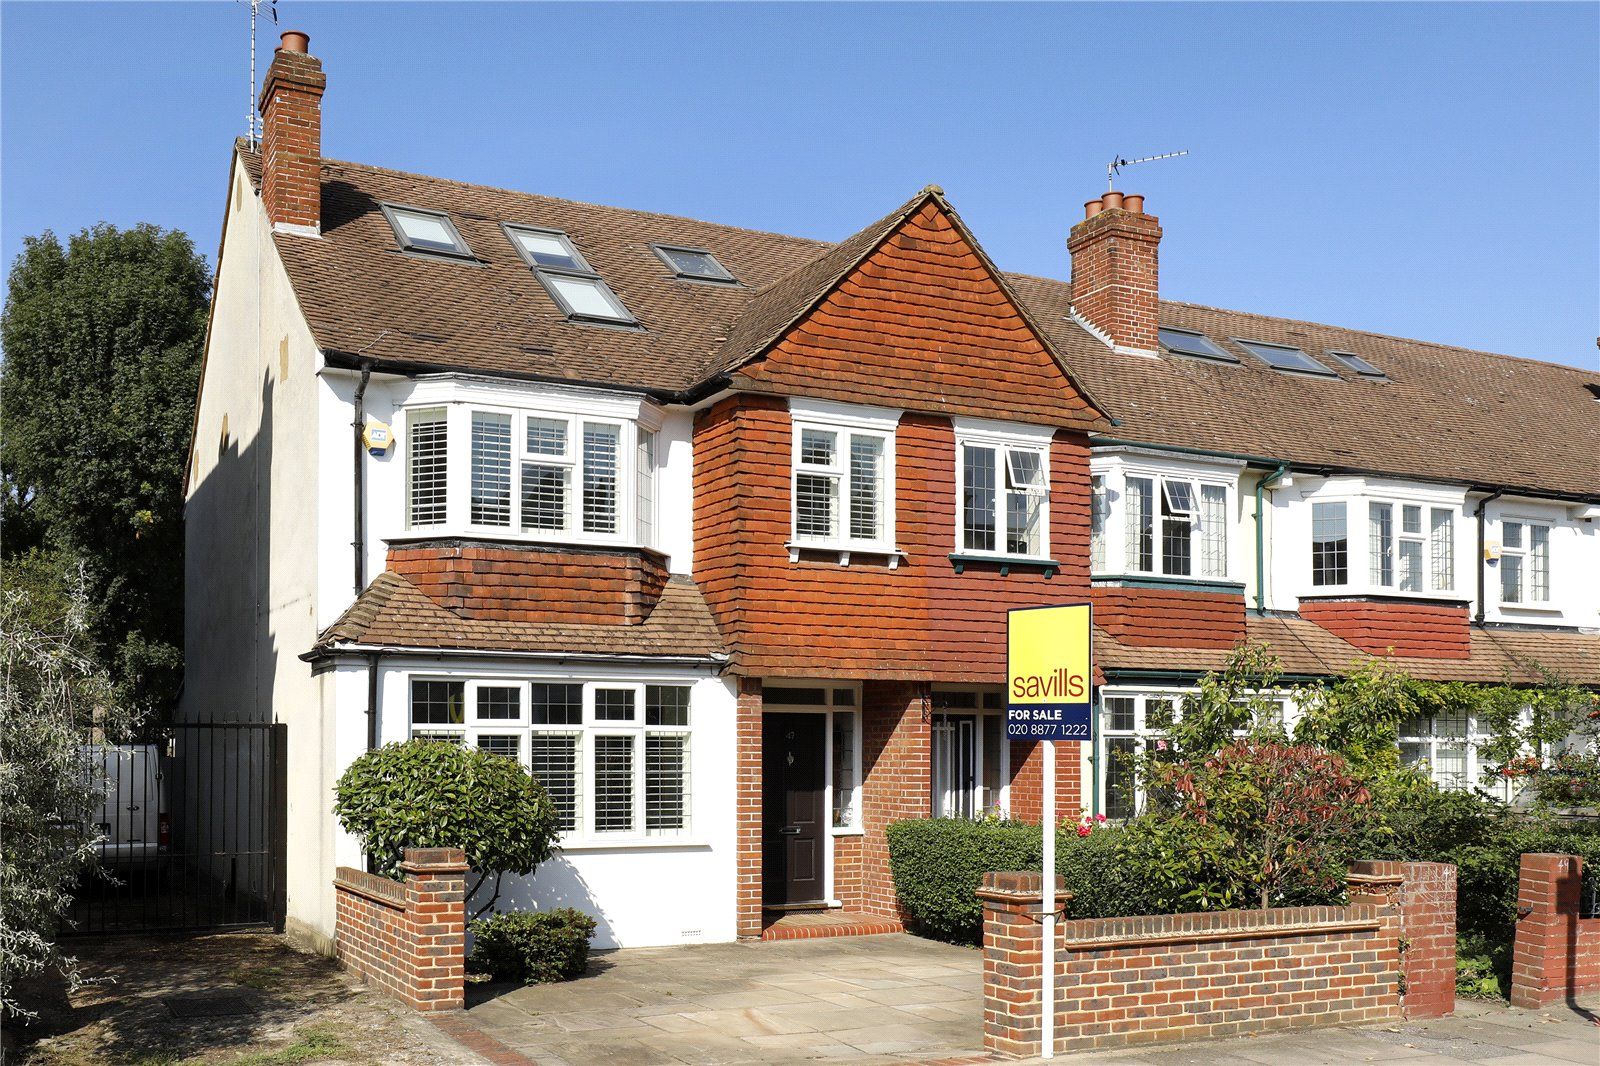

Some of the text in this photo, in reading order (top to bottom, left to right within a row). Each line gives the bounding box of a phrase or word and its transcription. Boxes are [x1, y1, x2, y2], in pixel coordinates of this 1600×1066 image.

[1013, 668, 1084, 697] savills
[1008, 710, 1062, 720] FOR SALE
[1008, 724, 1088, 736] 020 8877 1222
